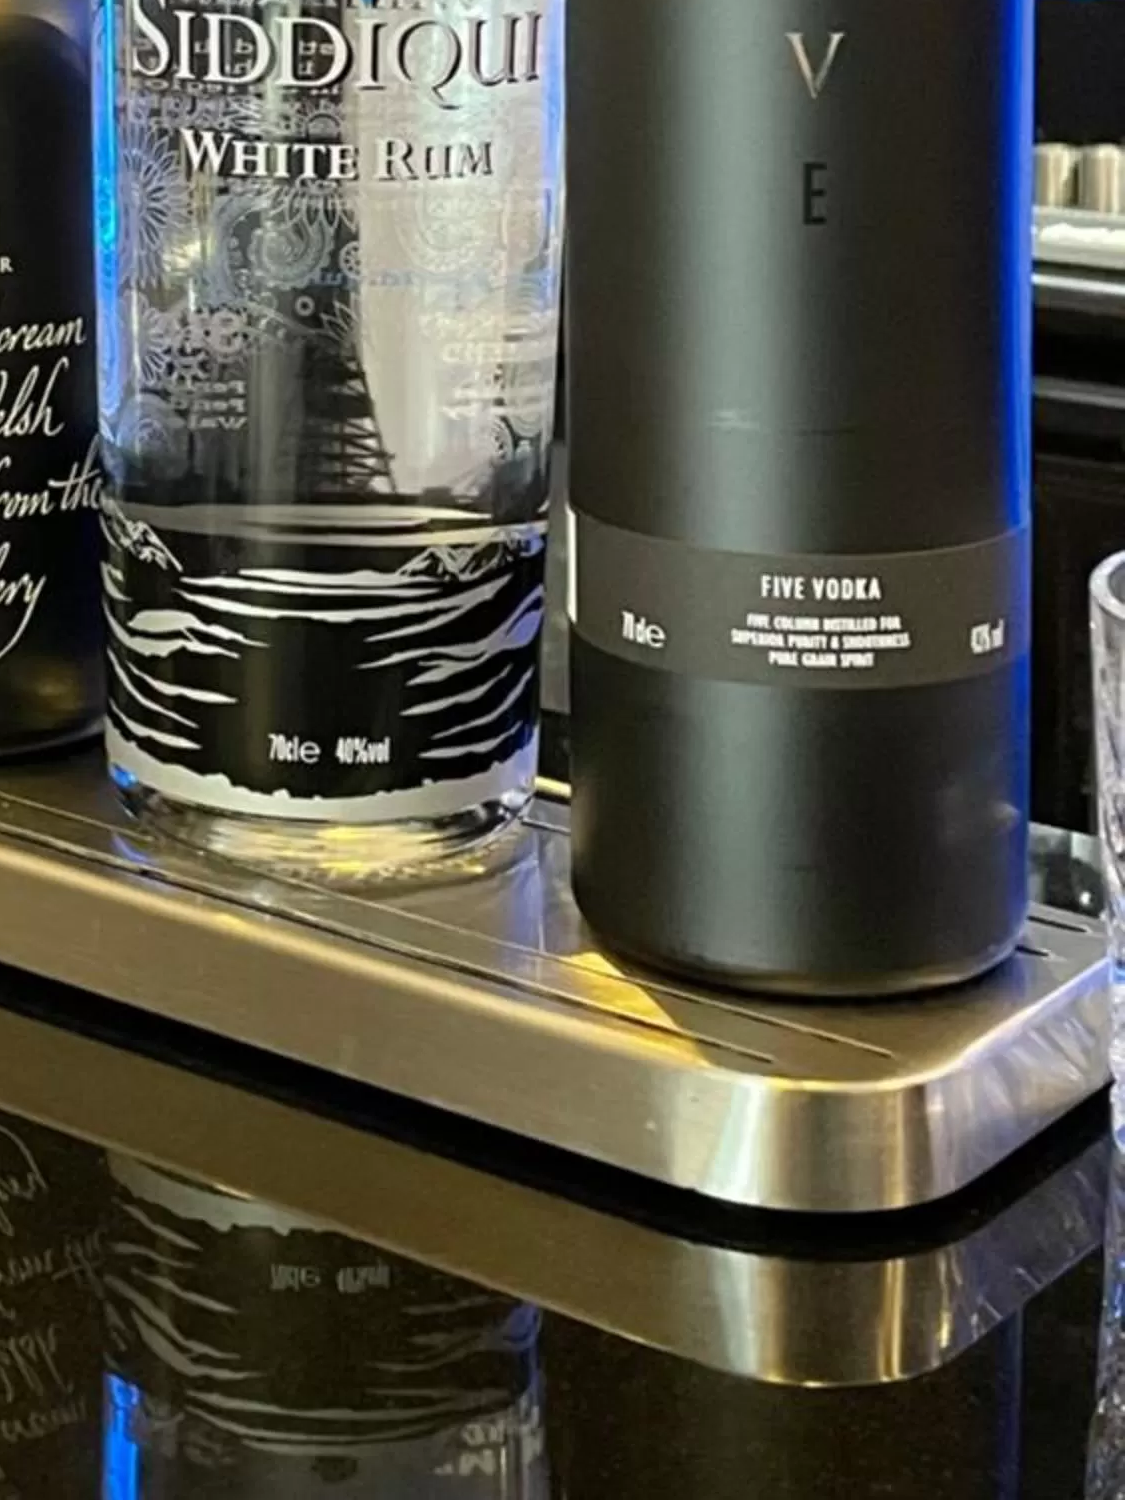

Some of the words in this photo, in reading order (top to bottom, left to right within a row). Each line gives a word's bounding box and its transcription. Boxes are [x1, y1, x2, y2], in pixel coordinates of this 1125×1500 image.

[180, 126, 359, 181] WHITE
[378, 139, 494, 182] RUM
[760, 574, 805, 599] FIVE
[811, 576, 882, 601] VODKA
